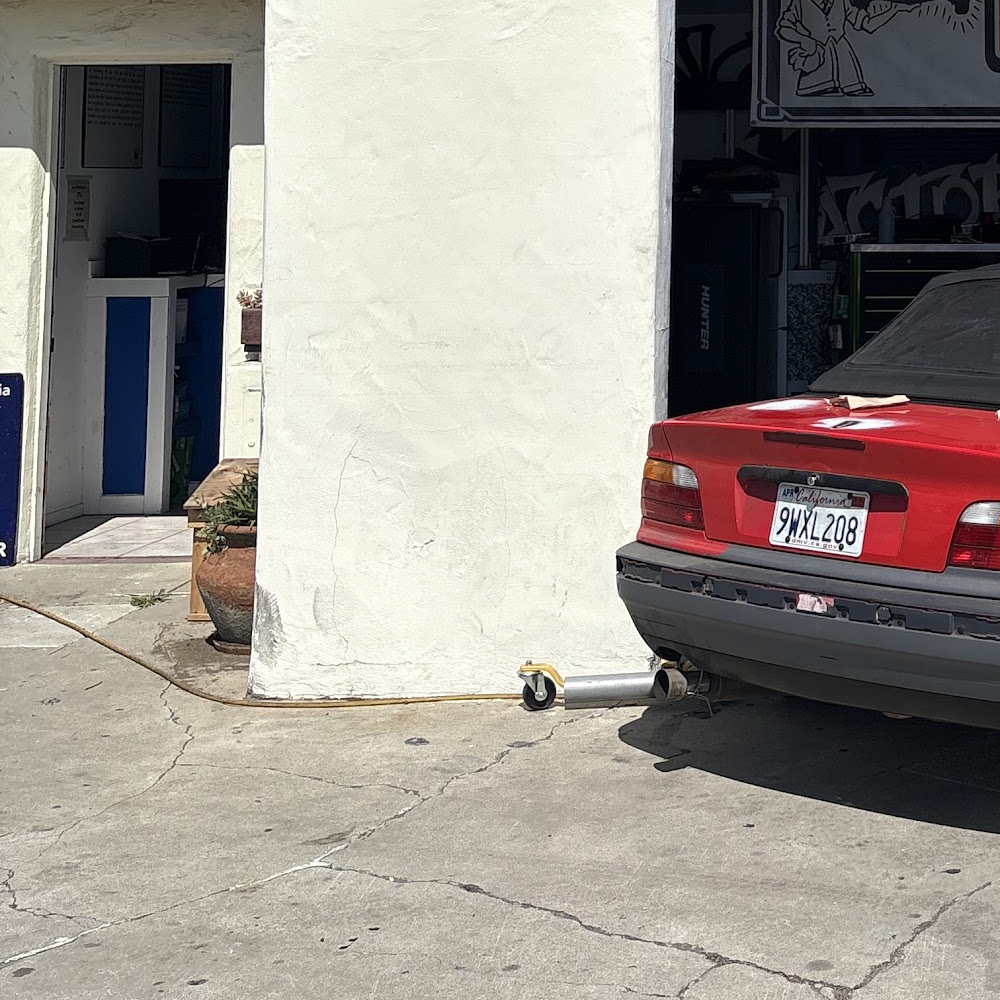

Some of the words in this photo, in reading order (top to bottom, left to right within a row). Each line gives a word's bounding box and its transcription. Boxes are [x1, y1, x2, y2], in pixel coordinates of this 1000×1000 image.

[700, 284, 710, 351] HUNTER
[782, 487, 794, 497] APR
[796, 487, 847, 507] California
[776, 507, 859, 546] 9WXL208
